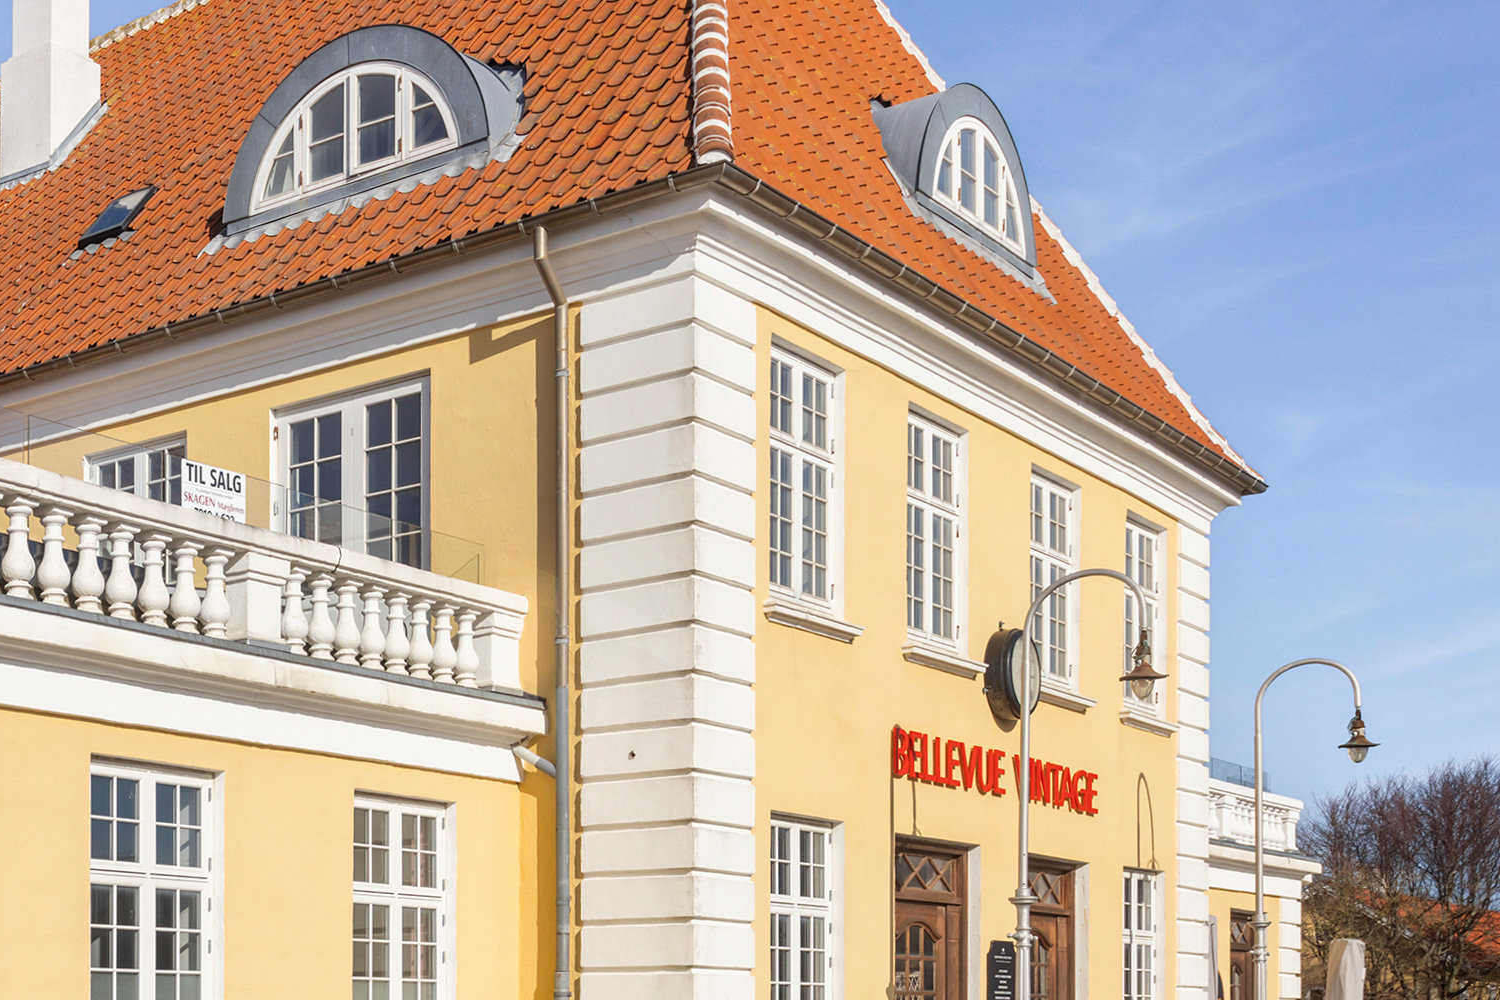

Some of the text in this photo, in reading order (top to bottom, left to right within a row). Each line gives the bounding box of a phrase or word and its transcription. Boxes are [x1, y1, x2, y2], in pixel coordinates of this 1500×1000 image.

[186, 462, 206, 485] TIL
[210, 469, 242, 494] SALG
[184, 491, 216, 508] SKAGEN
[892, 726, 1006, 795] BELLEVUE
